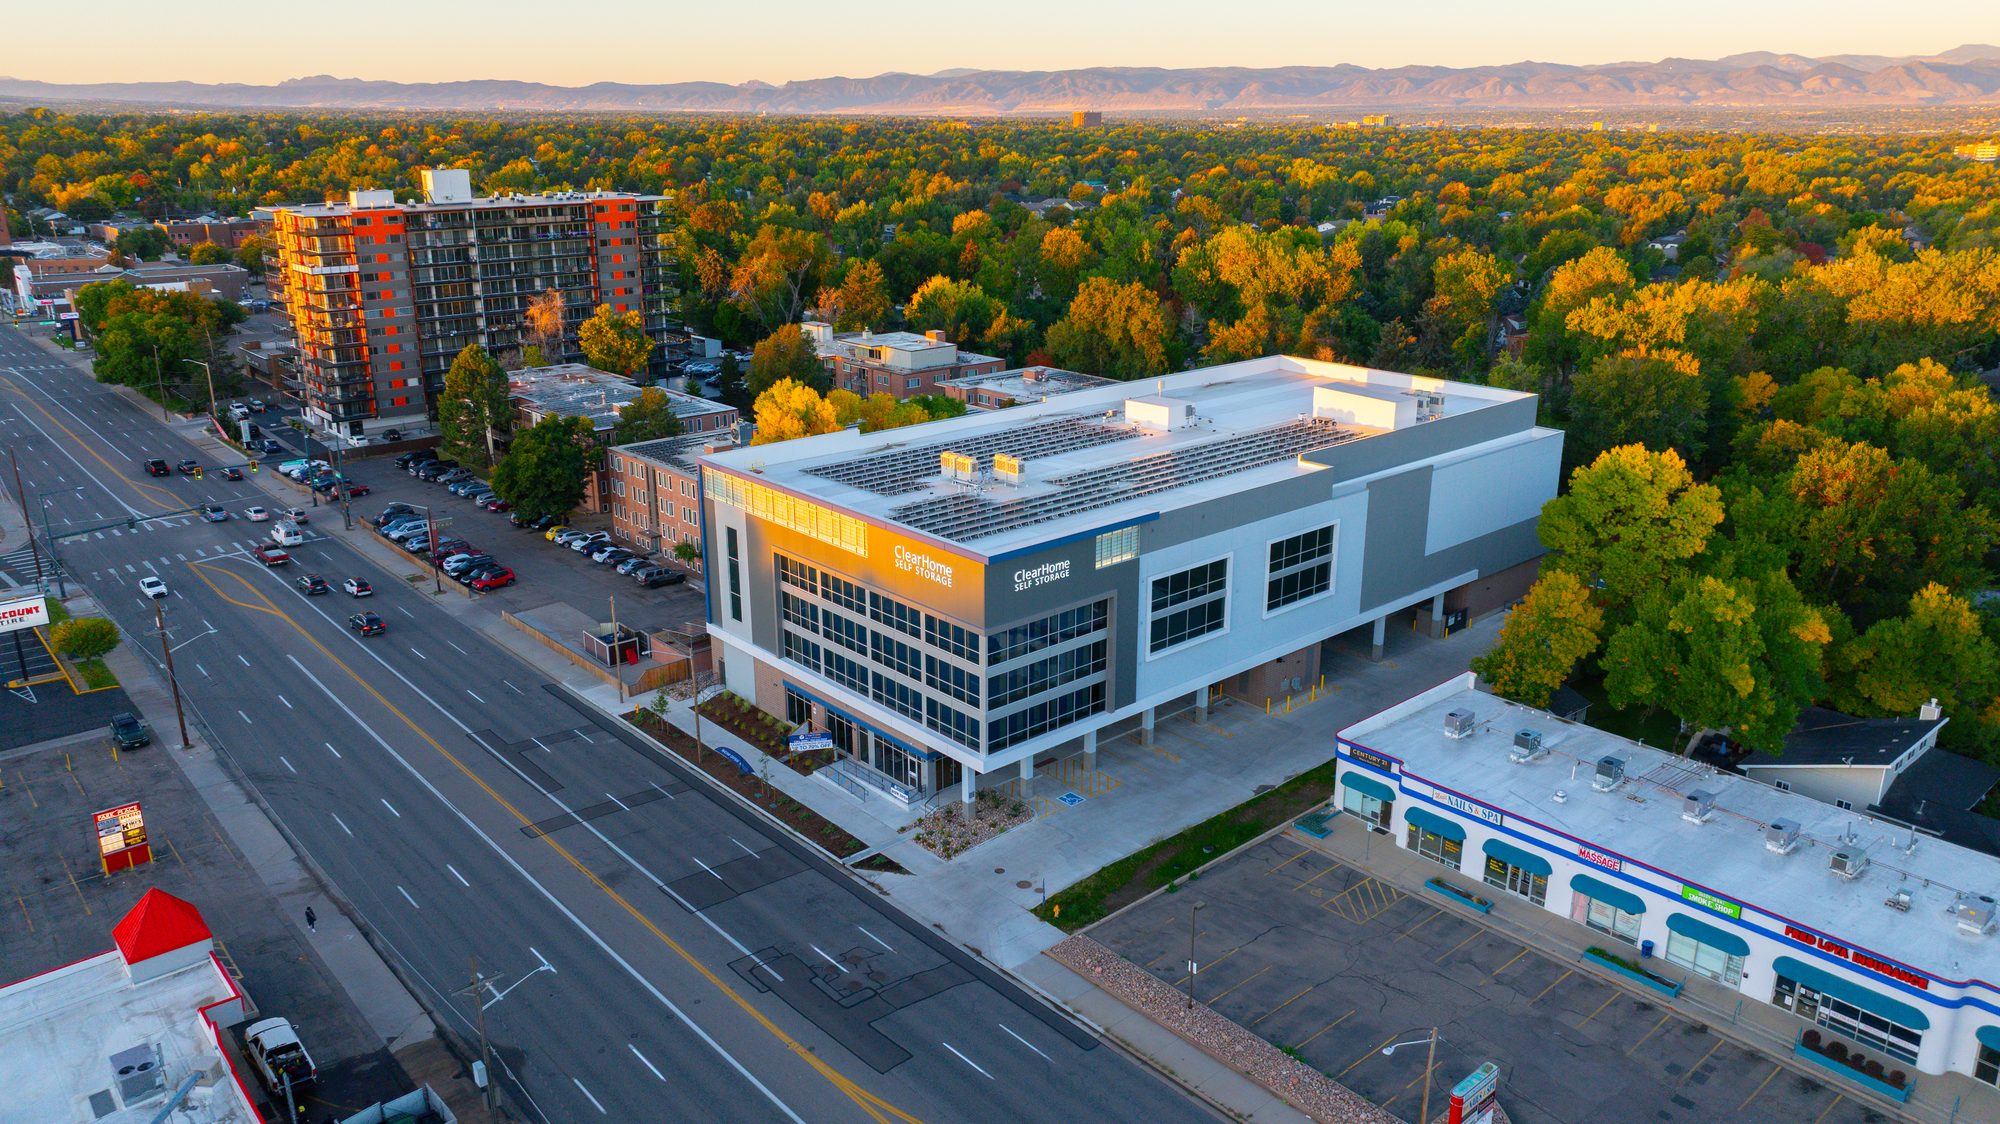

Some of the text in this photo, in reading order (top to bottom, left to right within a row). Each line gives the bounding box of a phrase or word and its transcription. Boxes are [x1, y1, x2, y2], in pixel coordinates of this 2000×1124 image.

[894, 545, 952, 577] ClearHome
[1014, 560, 1070, 583] ClearHome
[895, 558, 952, 588] SELF STORAGE
[1014, 569, 1070, 592] SELF STORAGE
[0, 617, 24, 626] TIRE
[1352, 748, 1381, 763] CENTURY
[1447, 795, 1474, 814] NAILS
[1474, 806, 1480, 816] &
[1481, 808, 1499, 824] SPA
[1578, 848, 1620, 871] MASSAGE
[1688, 893, 1713, 909] SMOKE
[1714, 903, 1734, 915] SHOP
[1784, 925, 1929, 990] FRED LOYA INSURANCE
